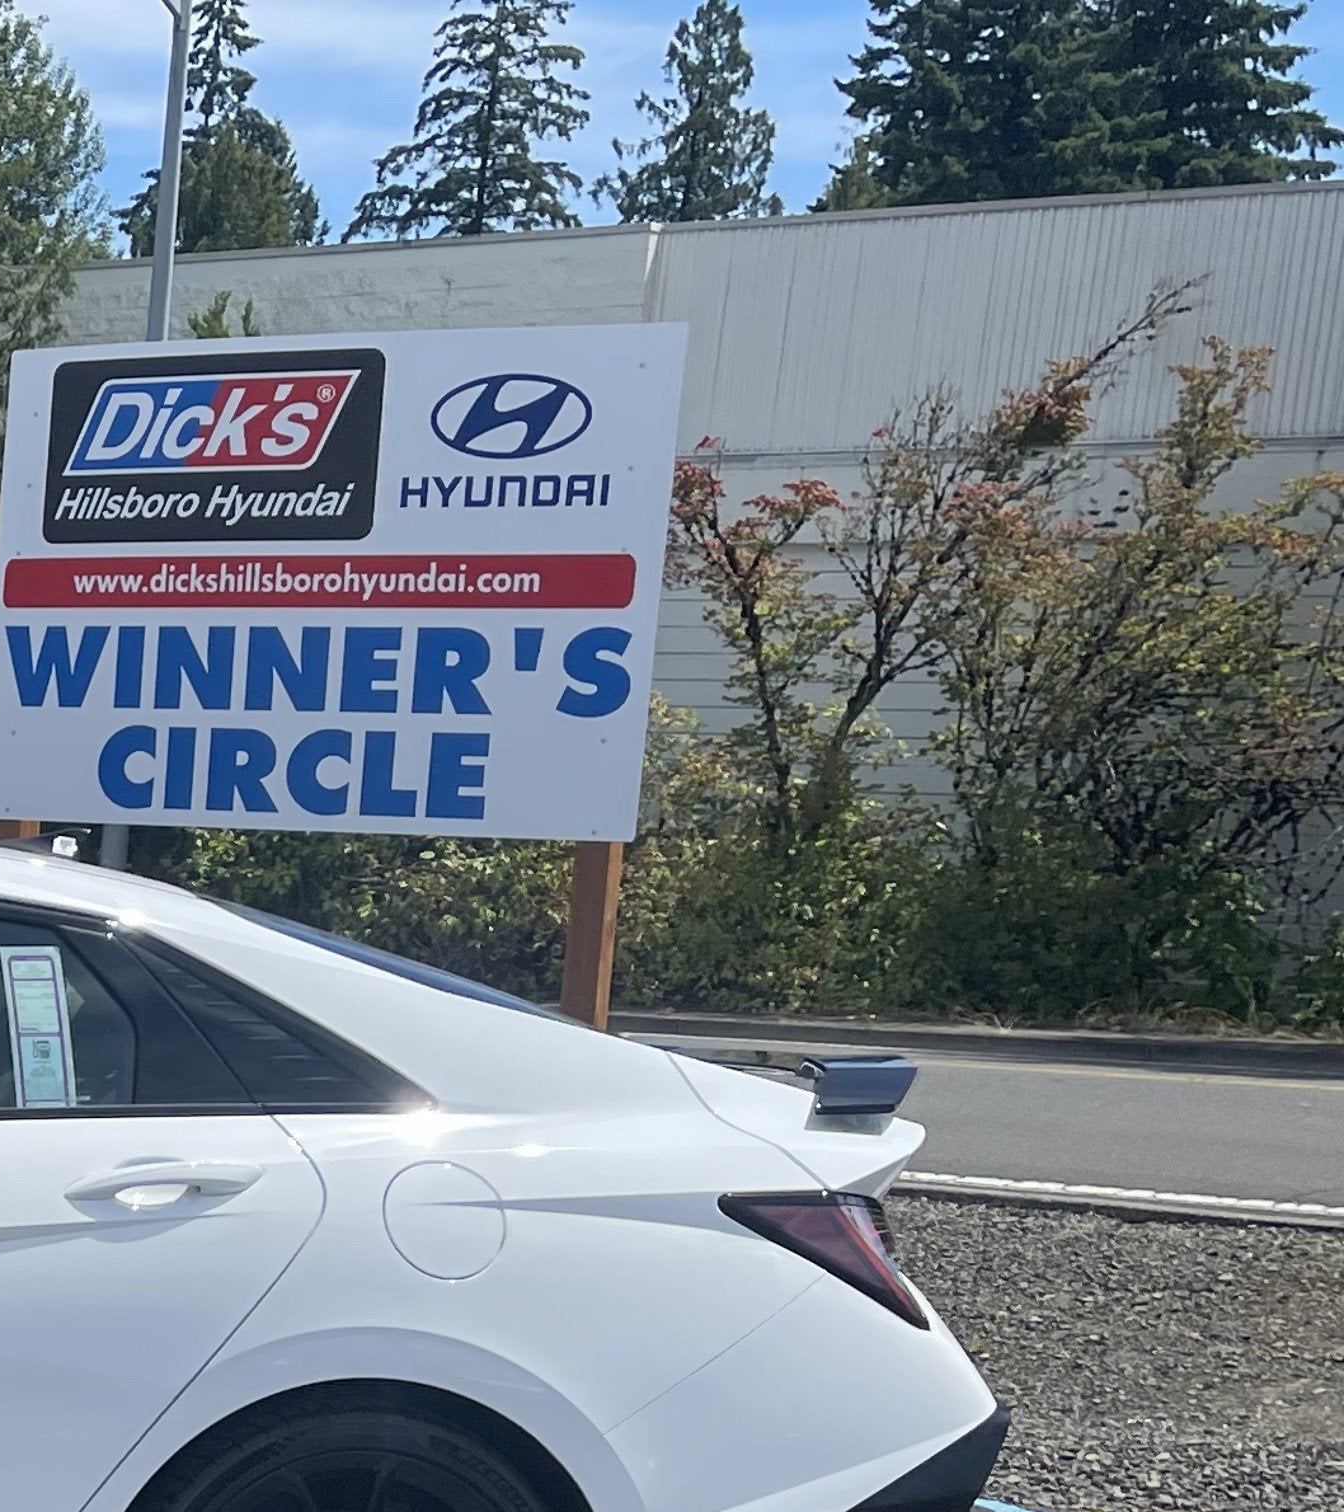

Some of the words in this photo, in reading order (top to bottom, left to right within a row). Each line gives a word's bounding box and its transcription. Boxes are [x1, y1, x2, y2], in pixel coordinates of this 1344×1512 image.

[84, 383, 320, 461] Dick's
[54, 485, 199, 521] Hillsboro
[205, 482, 356, 526] Hyundai
[399, 474, 611, 509] HYUNDAI
[72, 562, 541, 601] www.dickshillsborohyundai.com
[5, 625, 633, 718] WINNER'S
[97, 724, 491, 820] CIRCLE
